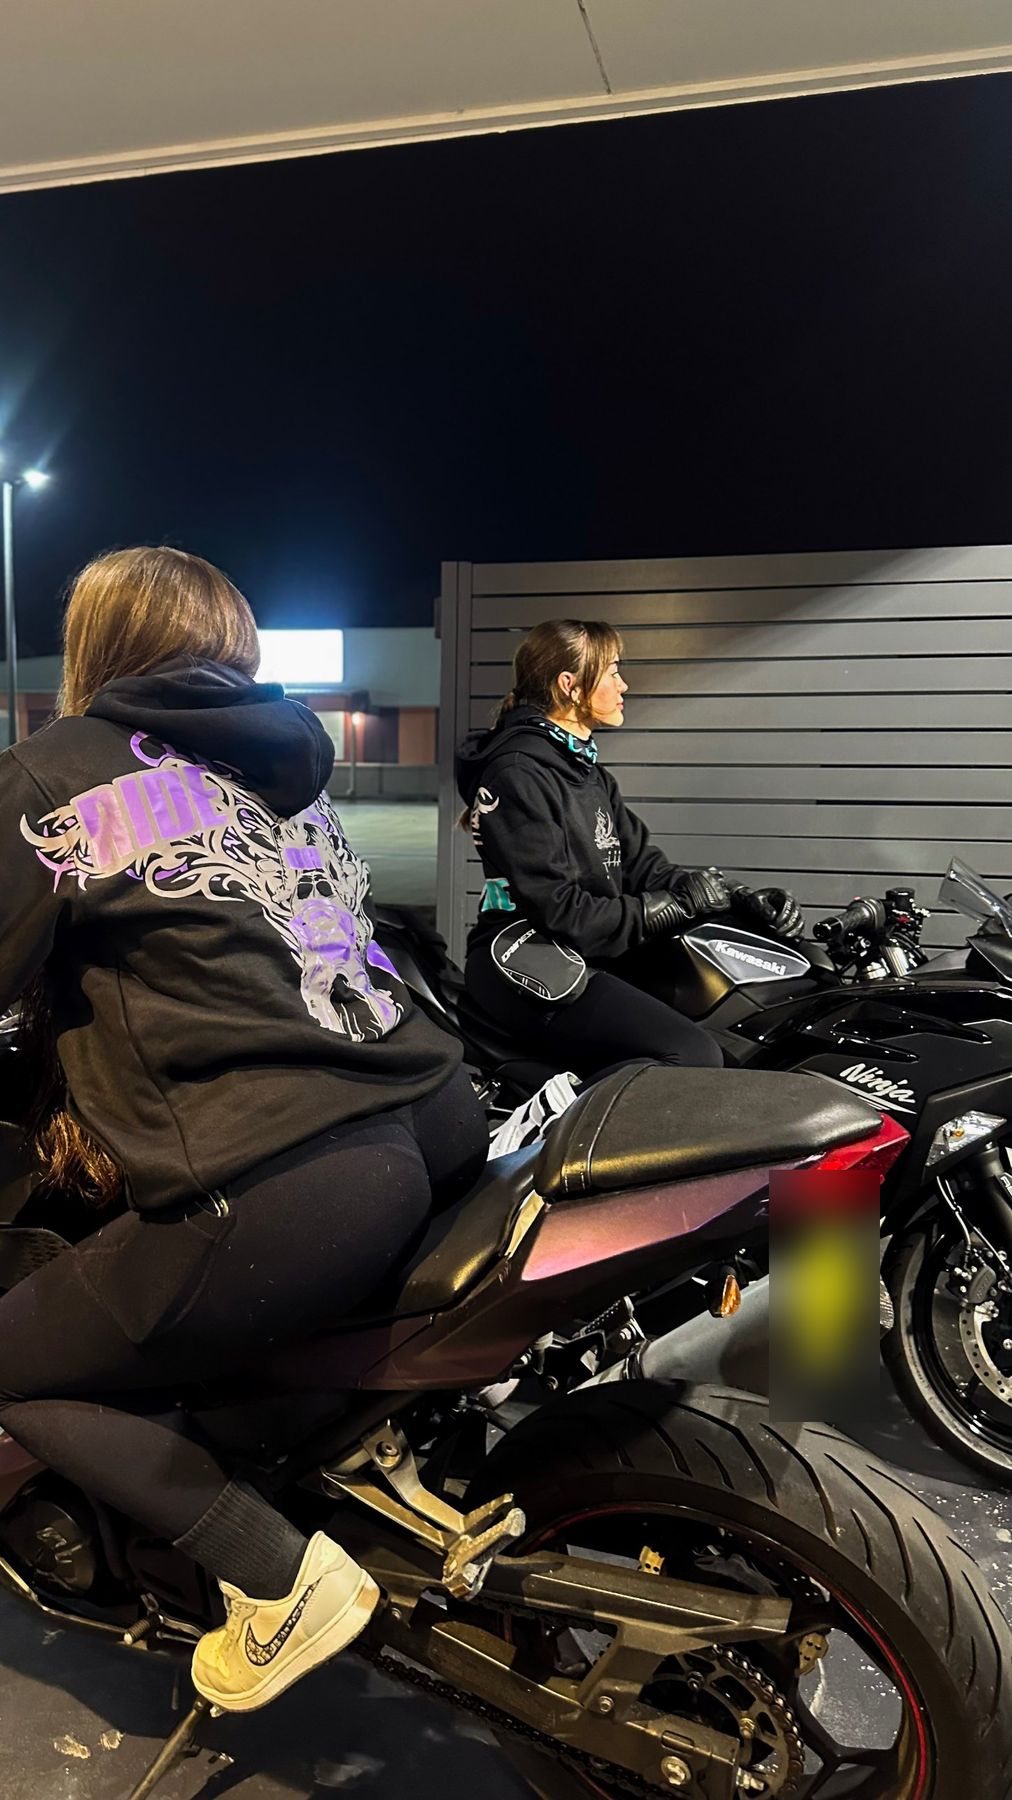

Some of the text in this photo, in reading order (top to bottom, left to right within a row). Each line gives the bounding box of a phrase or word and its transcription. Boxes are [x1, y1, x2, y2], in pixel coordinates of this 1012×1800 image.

[75, 765, 229, 869] RIDE
[714, 941, 787, 976] Kawasaki
[839, 1063, 916, 1103] Ninja
